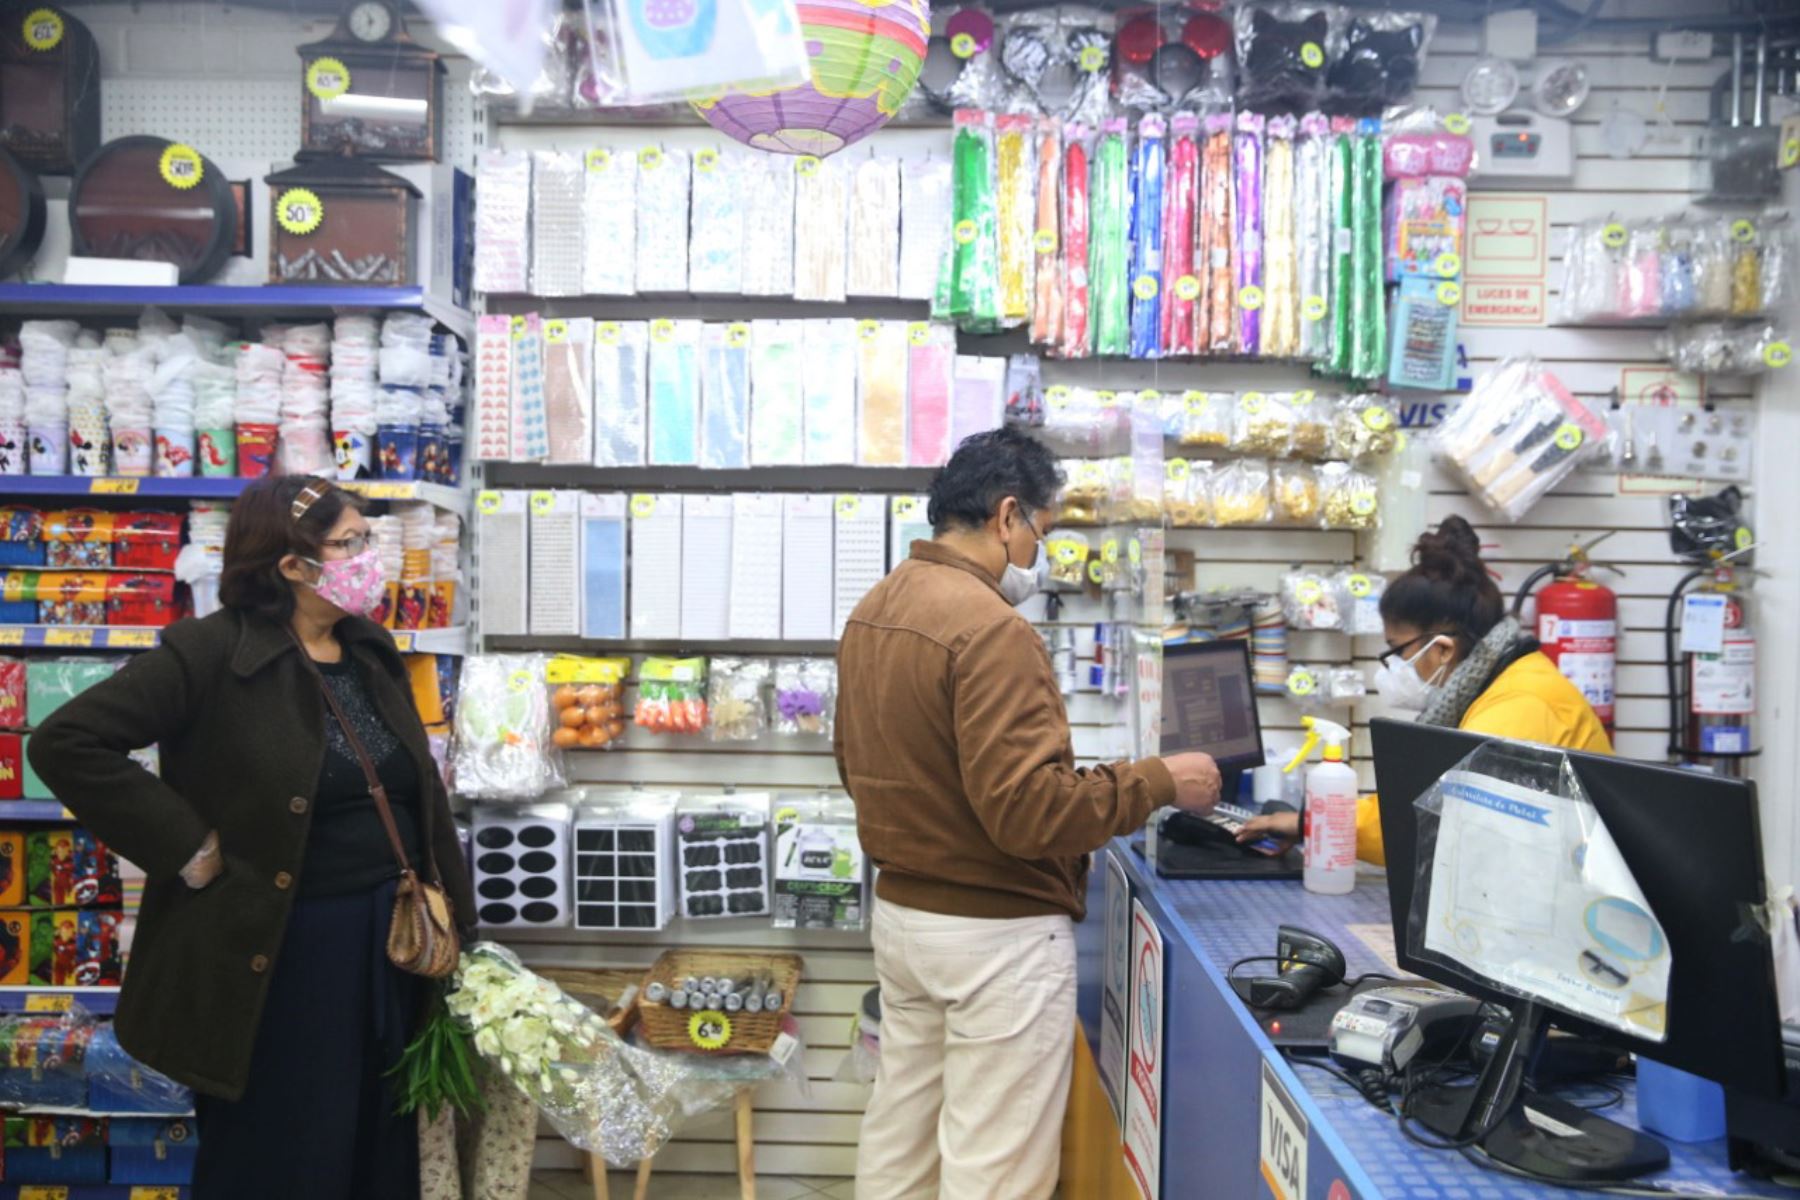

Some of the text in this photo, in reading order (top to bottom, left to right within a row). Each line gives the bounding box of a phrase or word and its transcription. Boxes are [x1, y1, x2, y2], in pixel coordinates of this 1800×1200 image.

[1477, 288, 1529, 299] LUCES DE
[1469, 305, 1538, 315] EMERGENCIA
[1400, 402, 1461, 427] VIS
[1266, 1100, 1301, 1199] VISA
